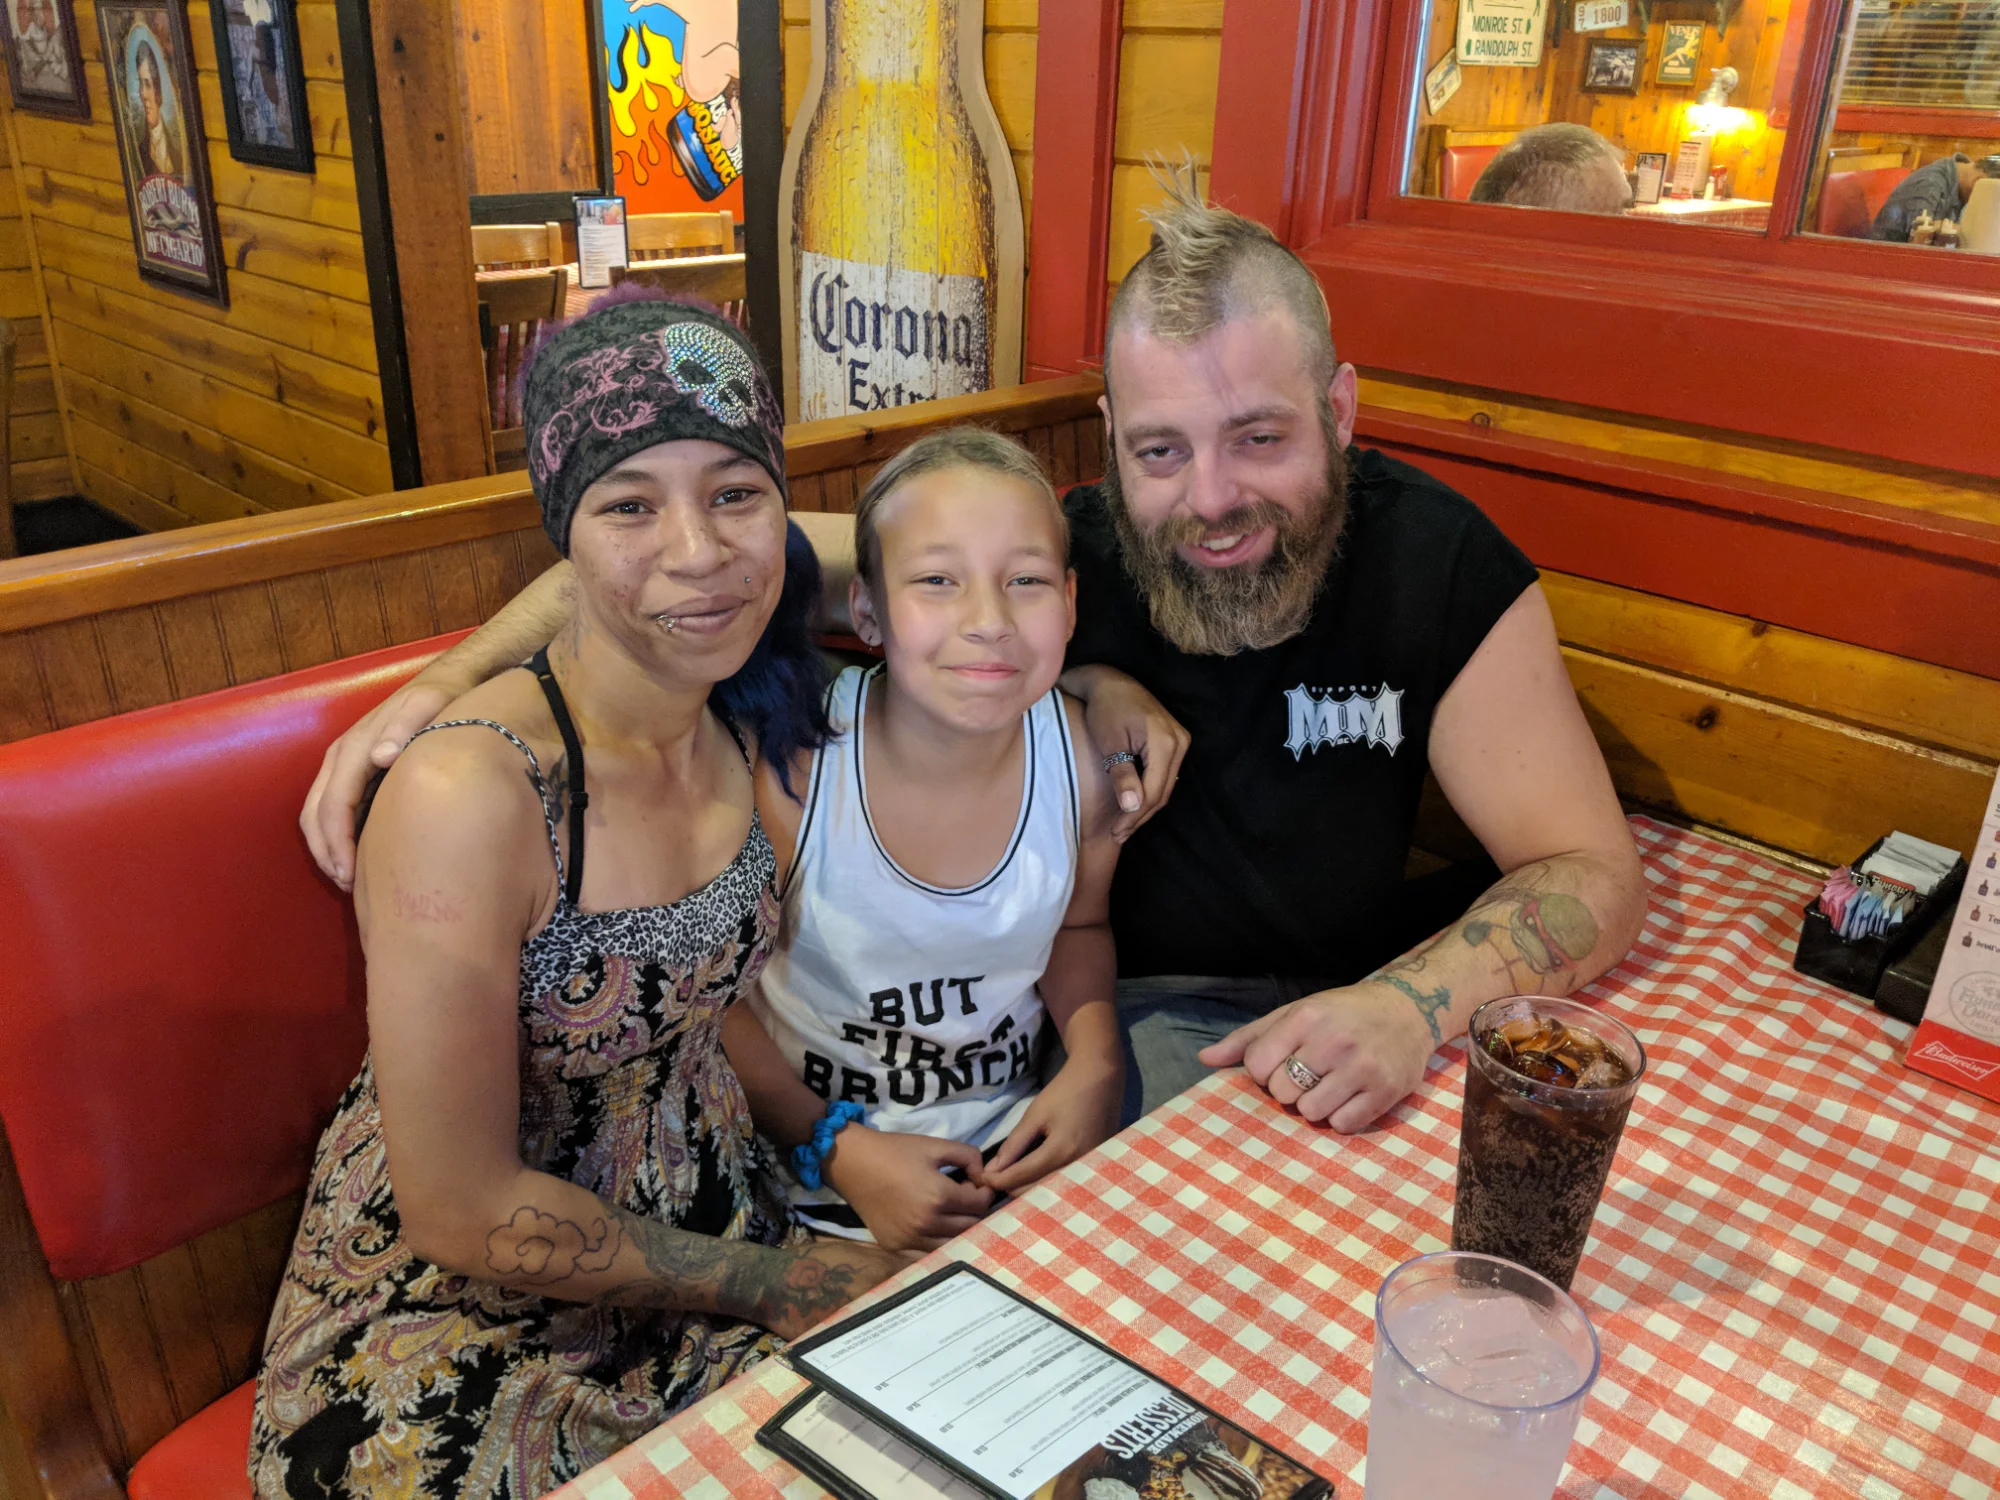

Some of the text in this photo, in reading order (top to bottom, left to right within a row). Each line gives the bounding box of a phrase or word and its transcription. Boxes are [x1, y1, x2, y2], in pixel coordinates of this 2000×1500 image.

[1472, 15, 1523, 34] MONROE ST.
[1594, 6, 1621, 24] 1800
[1474, 39, 1533, 57] RANDOLPH ST.
[139, 177, 200, 228] ROBERT BURNS
[160, 234, 191, 263] CIGAR
[809, 270, 972, 368] Corona
[847, 358, 938, 412] Extr
[869, 975, 986, 1028] BUT
[840, 1014, 1015, 1070] FIRST
[1925, 1044, 1989, 1074] Budweiser
[803, 1032, 1030, 1106] BRUNCH
[1102, 1394, 1196, 1460] DESSERTS
[1147, 1411, 1208, 1455] HOMEMADE
